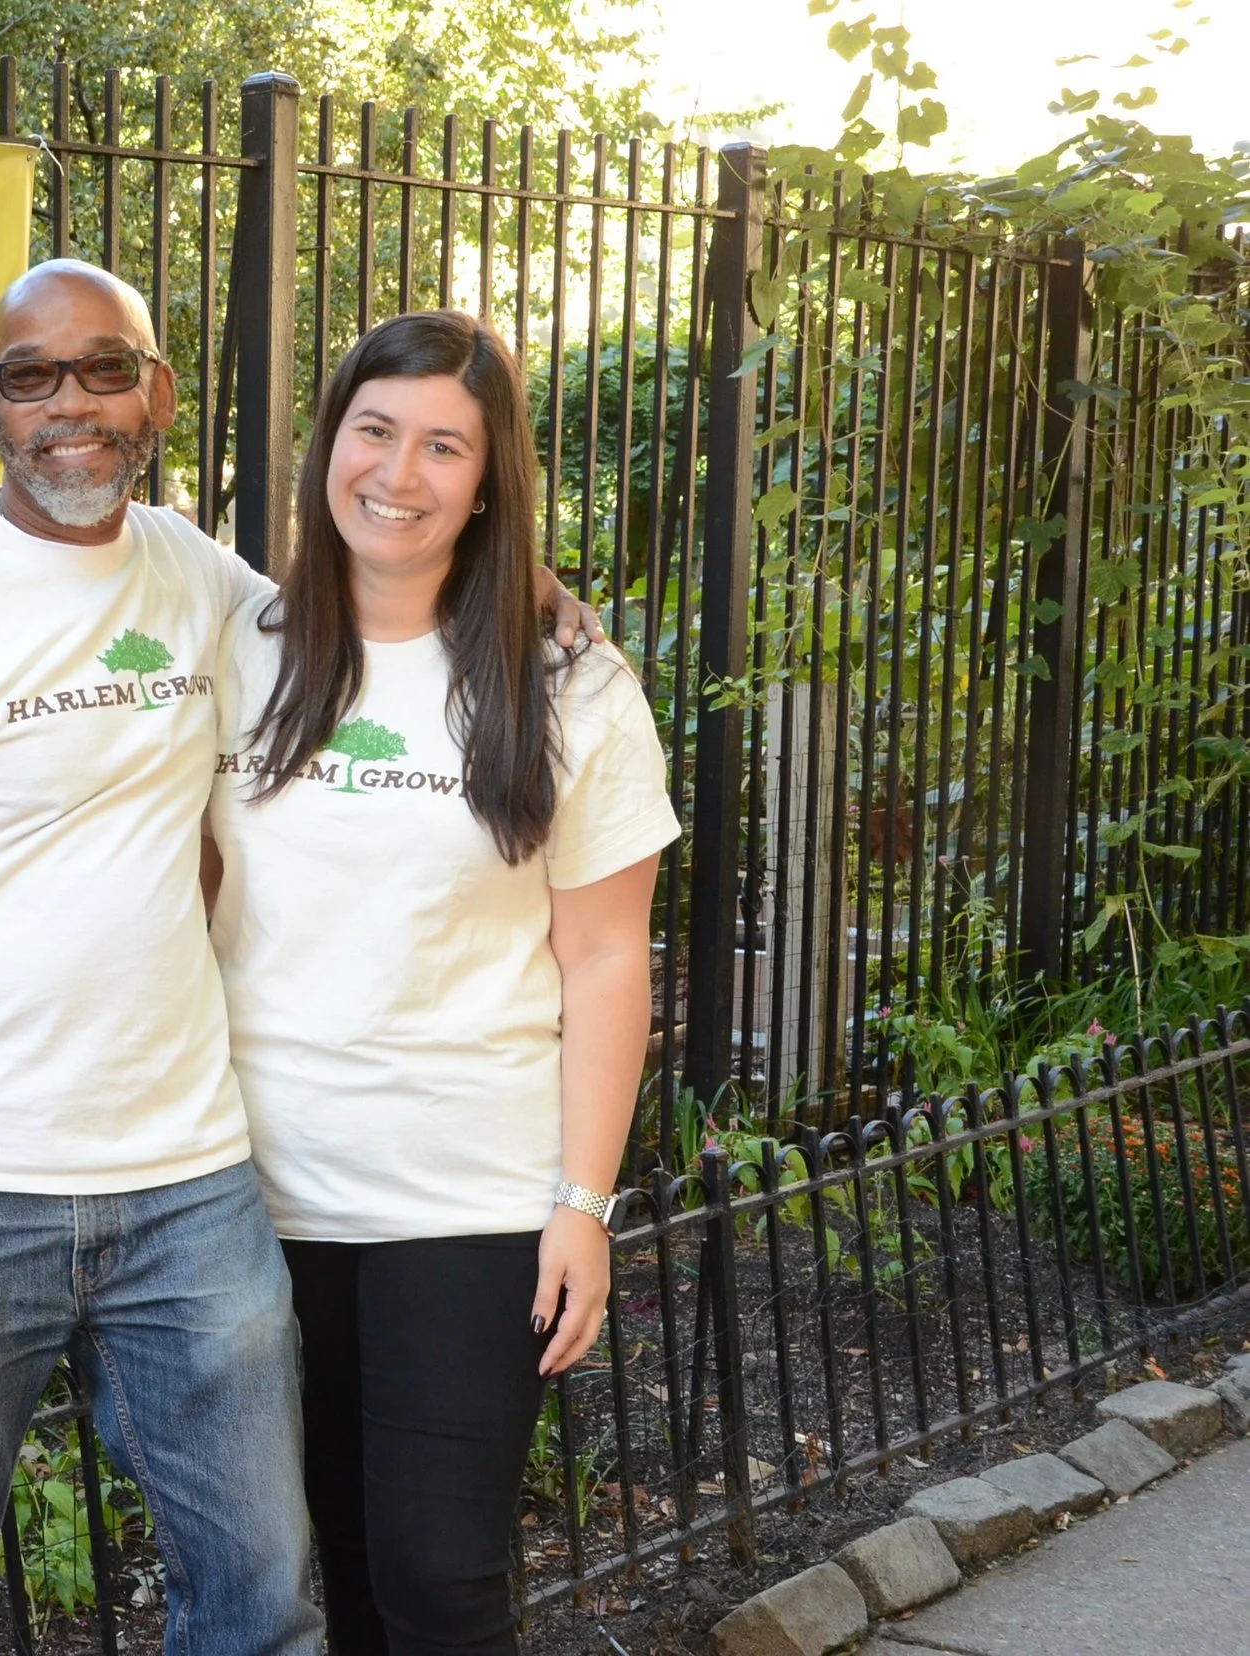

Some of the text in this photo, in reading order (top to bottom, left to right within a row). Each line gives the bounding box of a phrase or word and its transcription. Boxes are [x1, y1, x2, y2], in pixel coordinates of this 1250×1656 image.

[7, 682, 137, 724] HARLEM
[215, 753, 466, 798] HARM GROW
